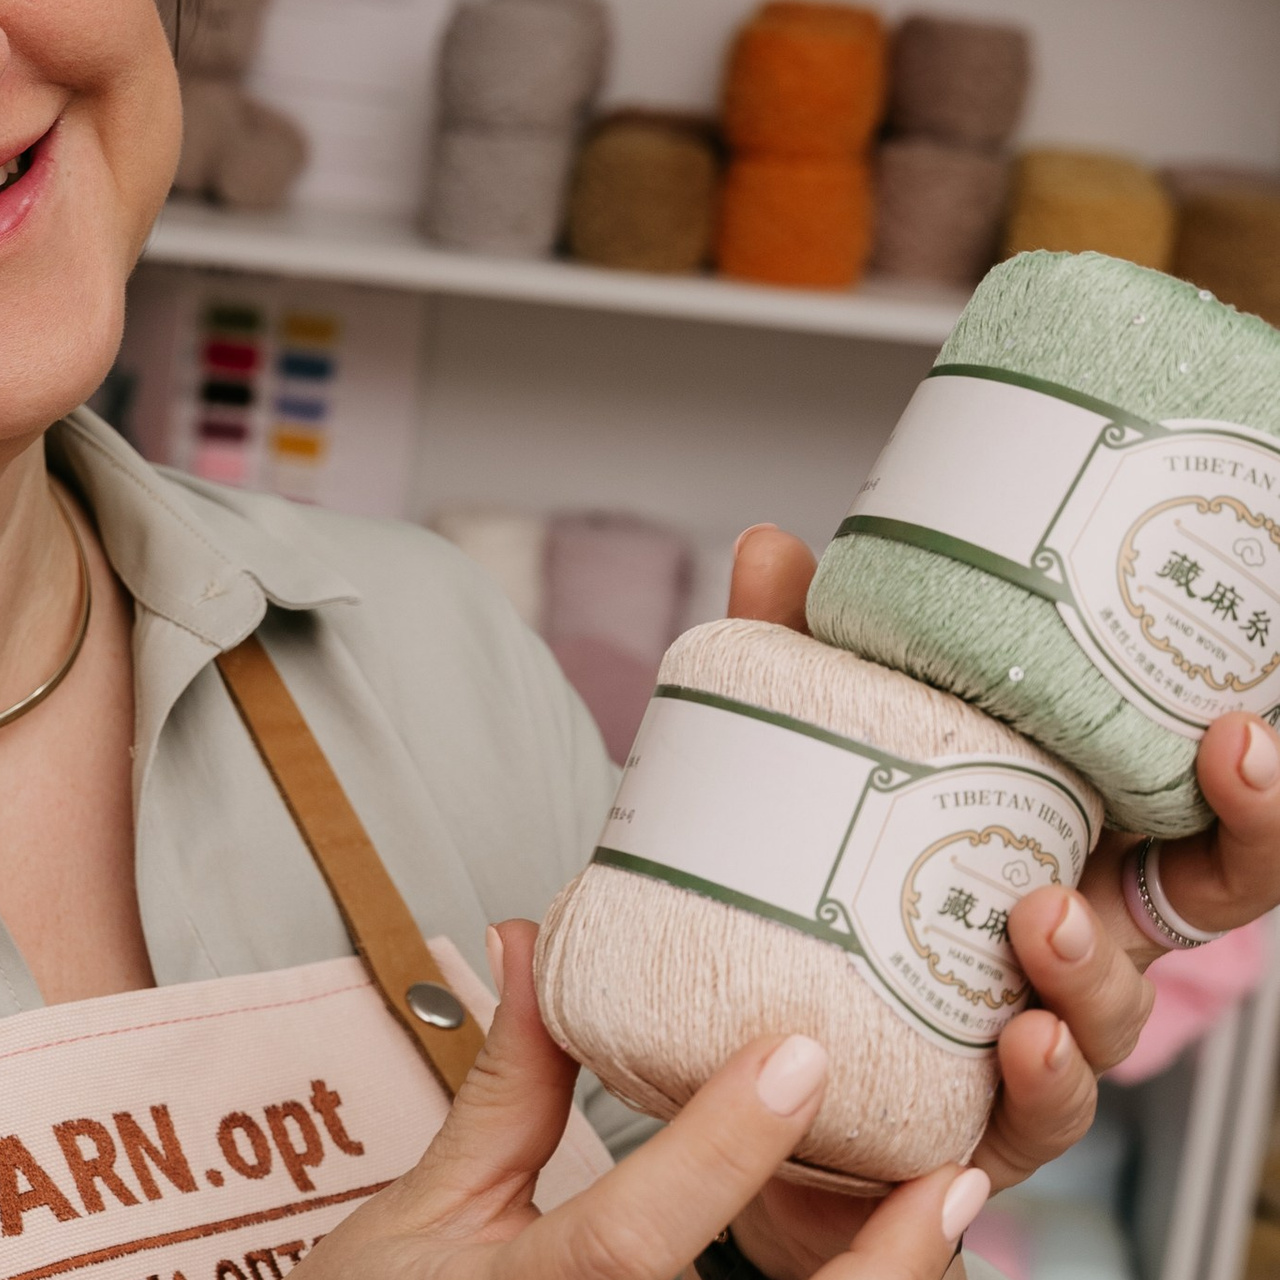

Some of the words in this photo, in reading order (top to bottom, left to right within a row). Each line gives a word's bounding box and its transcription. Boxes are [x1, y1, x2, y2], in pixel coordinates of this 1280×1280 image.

[1164, 455, 1276, 491] TIBETAN
[1165, 613, 1195, 638] HAND
[1195, 634, 1228, 663] WOVEN
[933, 789, 1036, 813] TIBETAN
[1037, 803, 1073, 840] HEMP
[937, 886, 1011, 945] 藏麻
[947, 947, 975, 968] HAND
